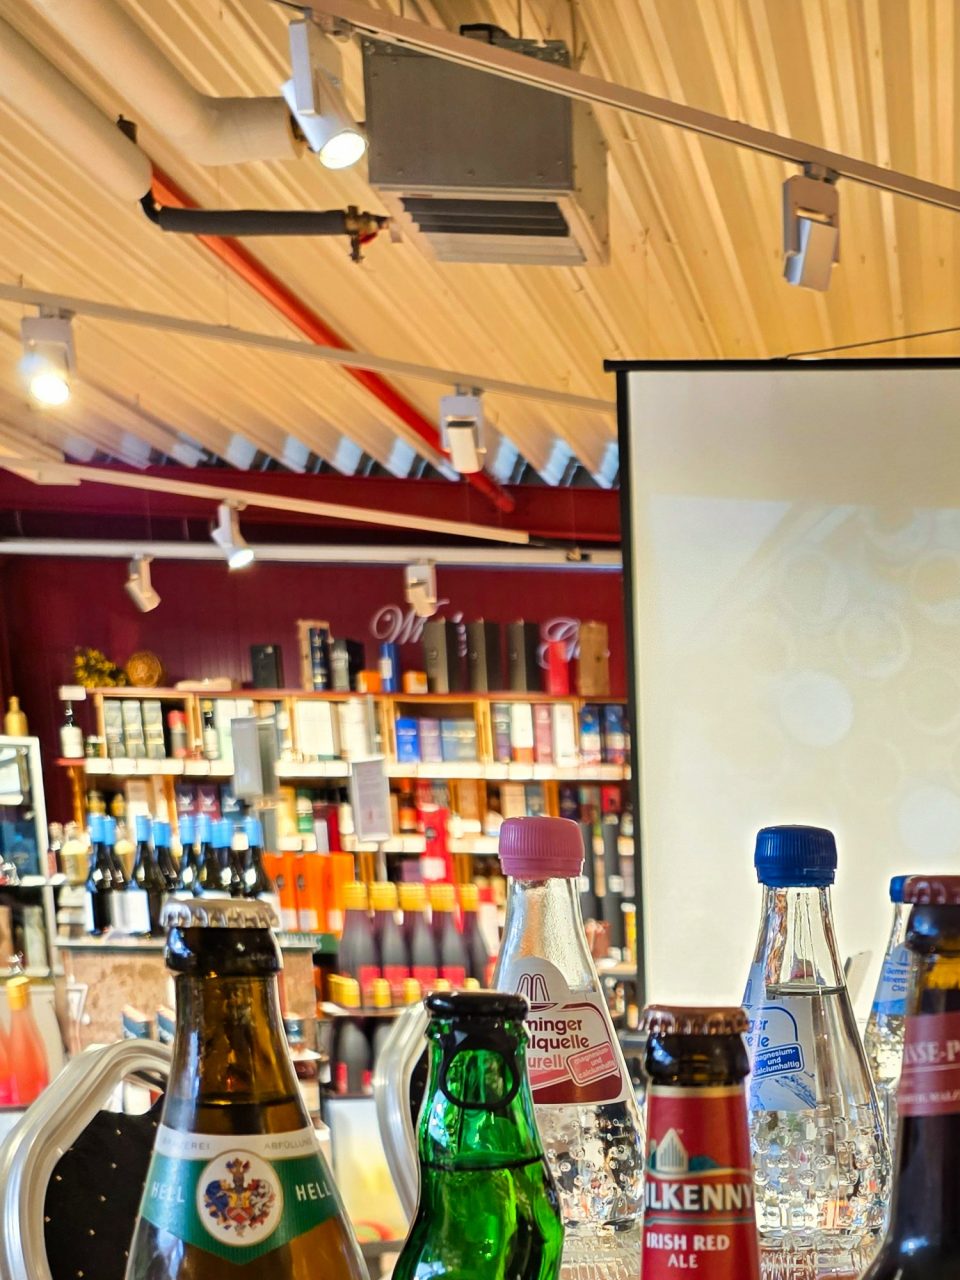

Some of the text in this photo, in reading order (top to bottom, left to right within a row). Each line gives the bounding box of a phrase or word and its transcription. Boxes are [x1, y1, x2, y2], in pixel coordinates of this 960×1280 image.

[151, 1181, 332, 1203] HELL HELL
[646, 1232, 731, 1251] IRISH RED
[667, 1253, 699, 1269] ALE
